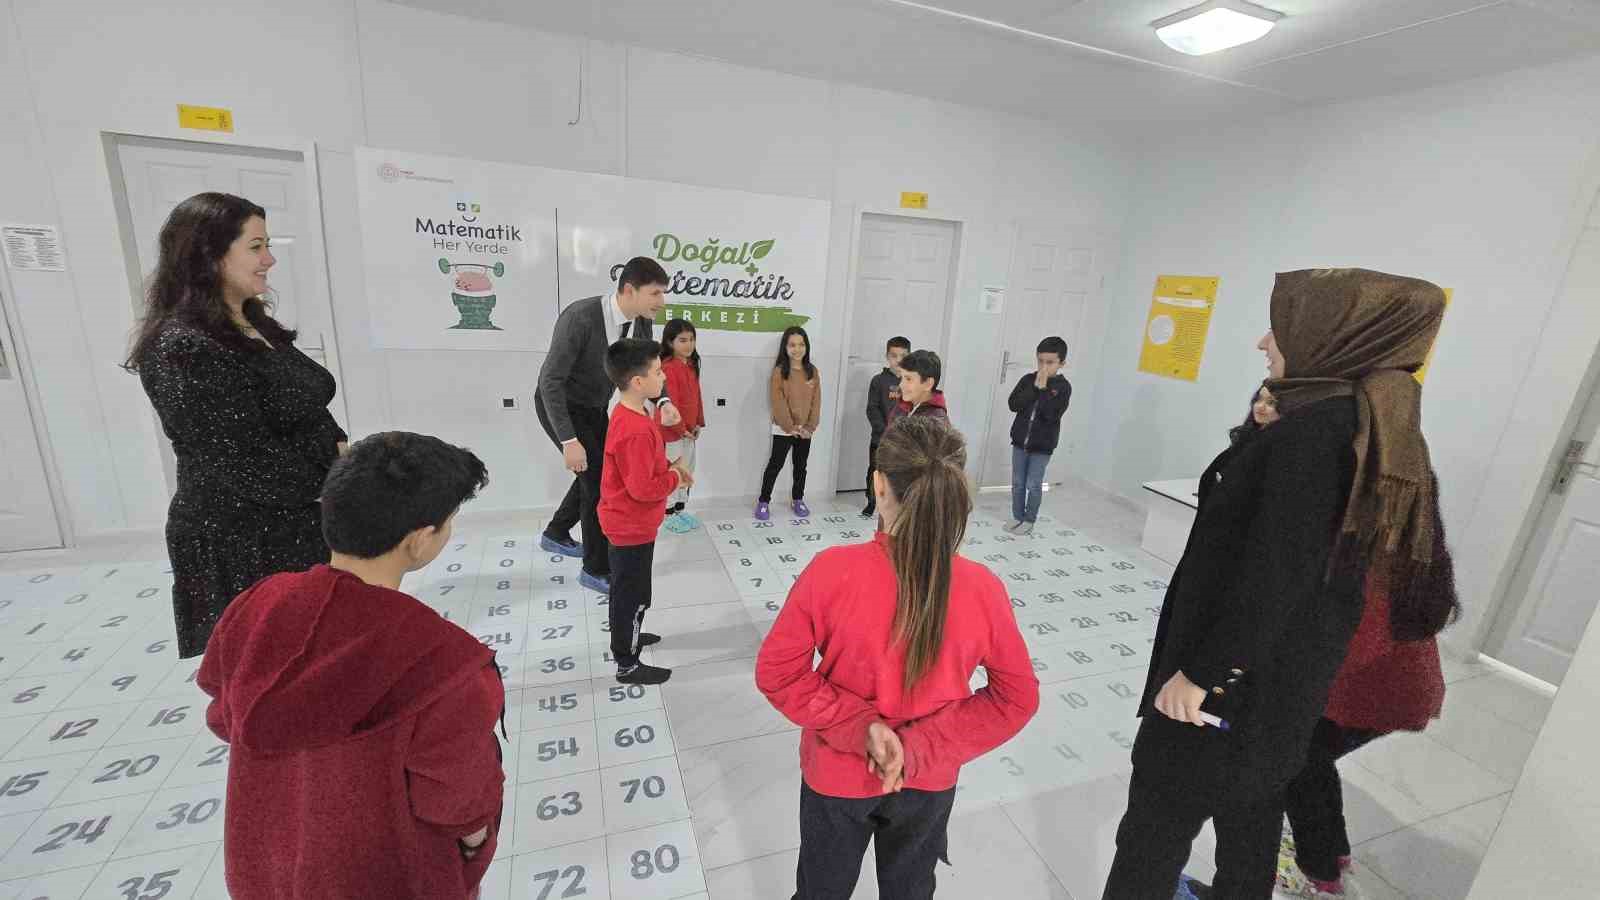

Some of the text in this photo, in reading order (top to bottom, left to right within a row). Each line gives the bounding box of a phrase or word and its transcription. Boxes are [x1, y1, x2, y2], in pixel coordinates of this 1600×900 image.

[415, 217, 522, 241] Matematik
[433, 238, 510, 255] Her Yerde
[652, 233, 753, 273] Doğal
[610, 263, 794, 301] tematik
[717, 522, 735, 531] 10
[752, 521, 775, 529] 20
[789, 518, 810, 527] 30
[824, 516, 846, 524] 40
[766, 536, 784, 545] 18
[801, 533, 822, 542] 27
[840, 530, 861, 539] 36
[504, 540, 516, 549] 8
[729, 539, 742, 548] 9
[500, 558, 514, 568] 0
[550, 554, 564, 563] 0
[740, 558, 752, 567] 8
[778, 554, 798, 564] 16
[446, 563, 462, 572] 0
[1111, 560, 1136, 571] 60
[29, 574, 52, 584] 0
[550, 575, 564, 585] 9
[750, 578, 763, 588] 7
[1008, 572, 1037, 582] 42
[439, 585, 455, 596] 7
[496, 580, 511, 591] 8
[1109, 584, 1136, 594] 45
[64, 594, 89, 604] 0
[136, 588, 160, 598] 0
[1038, 592, 1065, 604] 35
[1072, 588, 1101, 599] 40
[546, 599, 568, 611] 18
[597, 594, 609, 606] 2
[765, 601, 780, 612] 6
[487, 604, 511, 617] 16
[1108, 611, 1139, 623] 32
[25, 622, 48, 635] 1
[100, 616, 129, 628] 2
[1029, 622, 1060, 635] 24
[1071, 616, 1099, 629] 28
[541, 625, 573, 641] 27
[146, 640, 171, 653] 6
[1110, 643, 1136, 657] 21
[62, 646, 93, 662] 4
[1066, 650, 1093, 664] 18
[540, 656, 576, 674] 36
[111, 676, 137, 692] 9
[12, 685, 47, 704] 6
[608, 684, 646, 702] 50
[537, 693, 578, 713] 45
[1060, 691, 1089, 710] 10
[147, 706, 191, 727] 16
[48, 718, 99, 742] 12
[614, 724, 655, 748] 60
[537, 736, 580, 762] 54
[197, 745, 229, 767] 2
[92, 755, 160, 784] 20
[0, 771, 49, 797] 15
[619, 775, 666, 804] 70
[535, 791, 584, 822] 63
[156, 798, 221, 830] 30
[32, 815, 112, 855] 24
[629, 844, 680, 881] 80
[533, 864, 587, 900] 72
